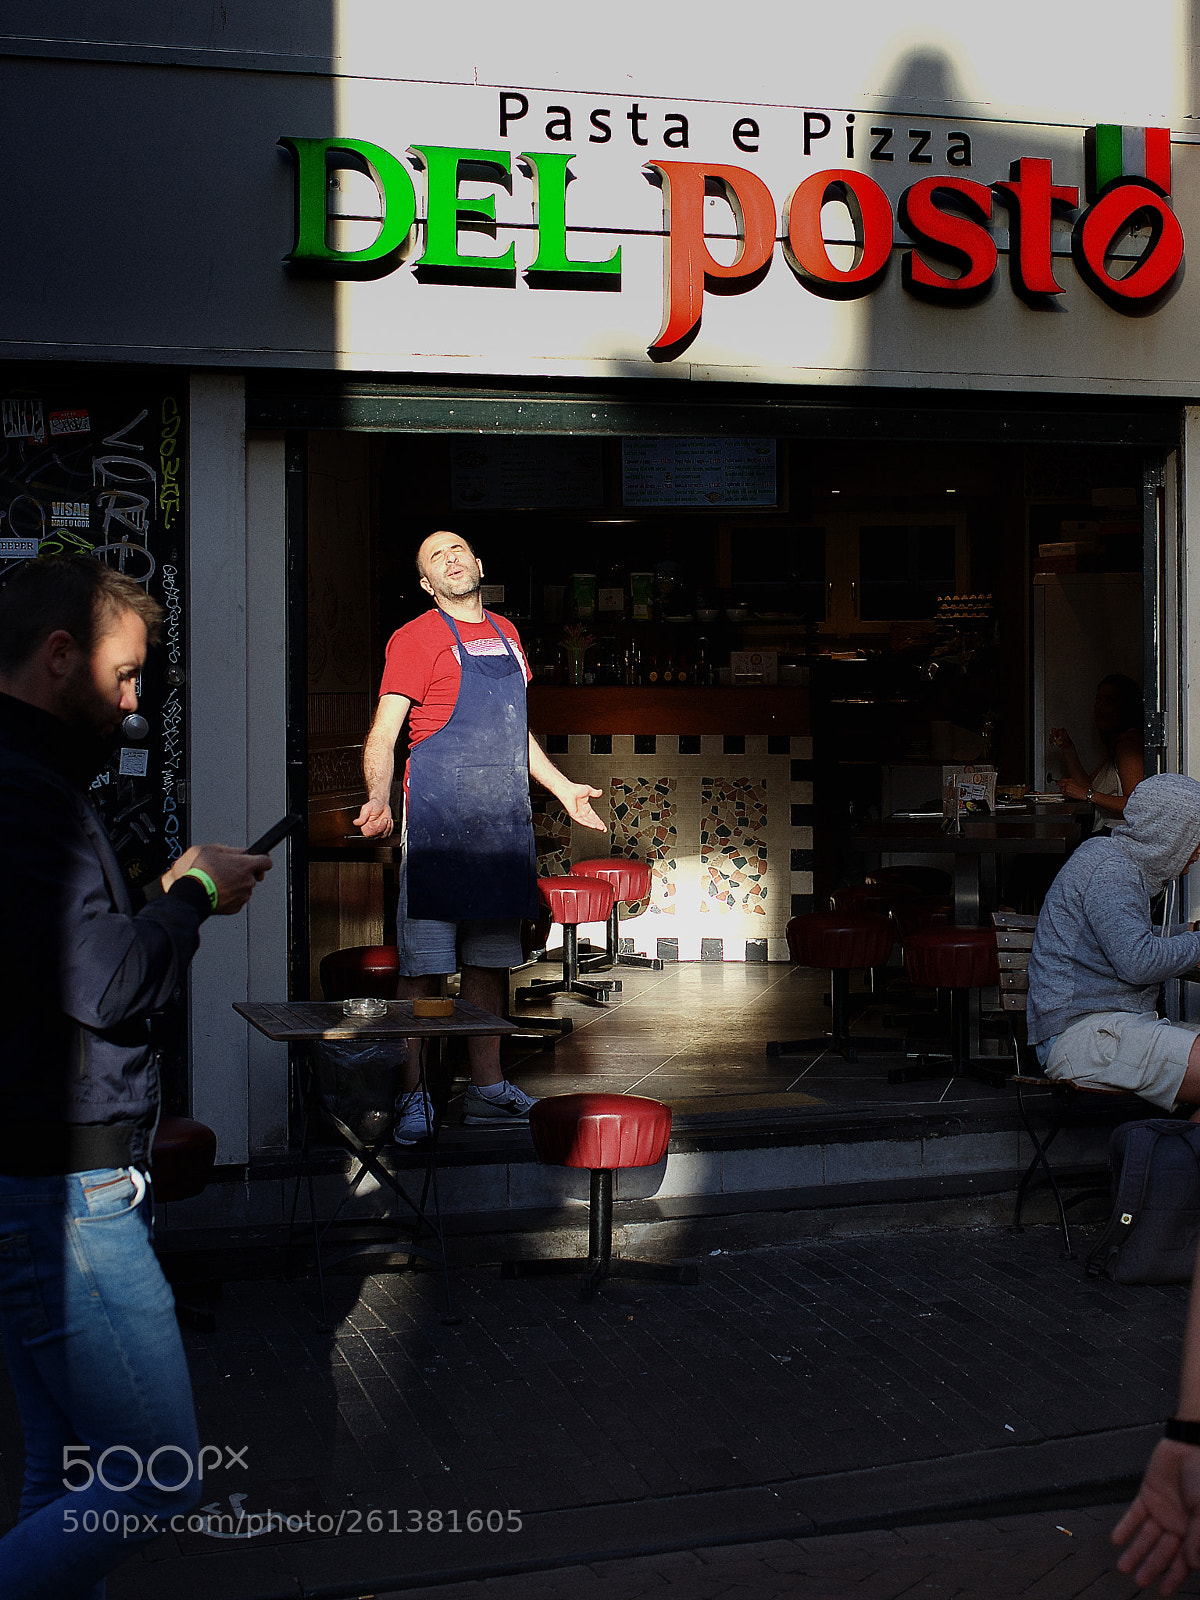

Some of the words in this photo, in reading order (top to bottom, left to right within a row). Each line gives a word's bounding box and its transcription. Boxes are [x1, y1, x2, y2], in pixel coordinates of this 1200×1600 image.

[498, 91, 690, 150] Pasta
[732, 116, 761, 153] e
[803, 111, 973, 168] Pizza
[276, 136, 622, 290] DEL
[0, 541, 34, 550] EEPER
[75, 520, 90, 528] LOOK
